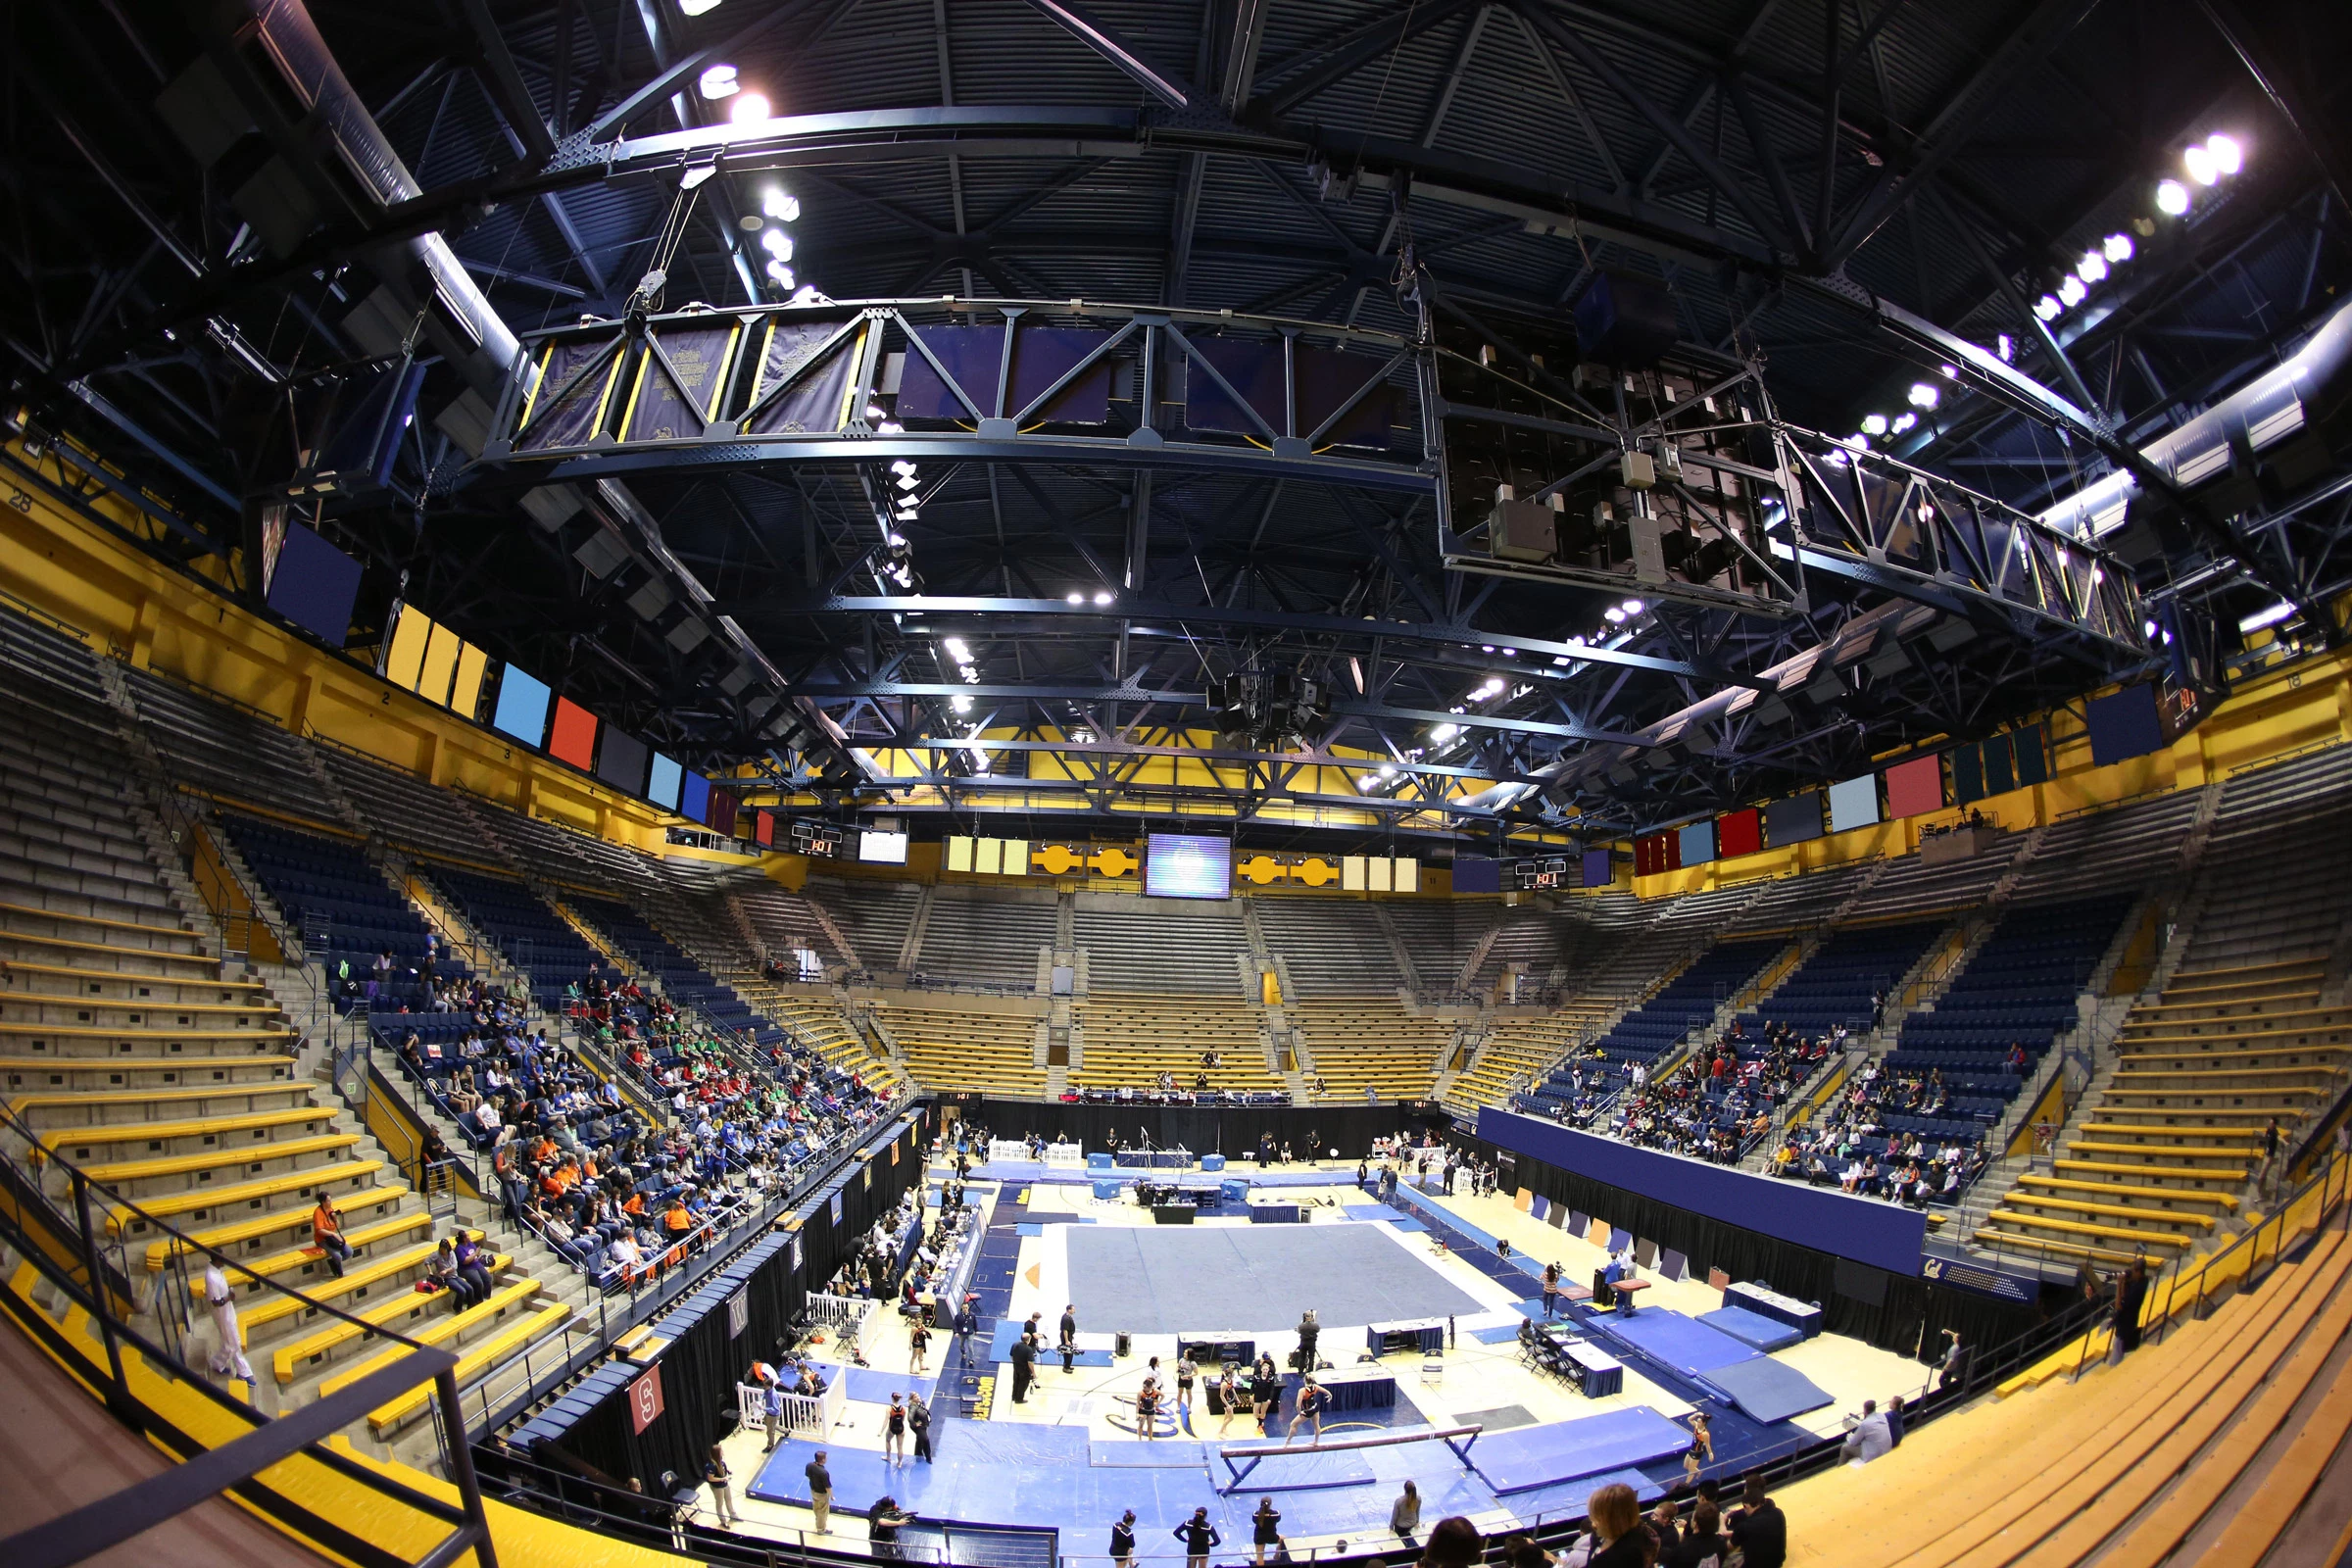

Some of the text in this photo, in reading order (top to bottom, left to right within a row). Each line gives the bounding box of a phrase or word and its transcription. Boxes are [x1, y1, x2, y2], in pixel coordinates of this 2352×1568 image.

[9, 487, 31, 513] 28
[2287, 675, 2301, 689] 18
[382, 692, 390, 704] 2
[505, 749, 510, 759] 3
[590, 787, 594, 796] 4
[811, 840, 832, 854] 1:01
[1537, 872, 1557, 884] 1:01
[1923, 1258, 1943, 1279] Cal
[731, 1293, 747, 1330] W
[639, 1377, 655, 1423] S
